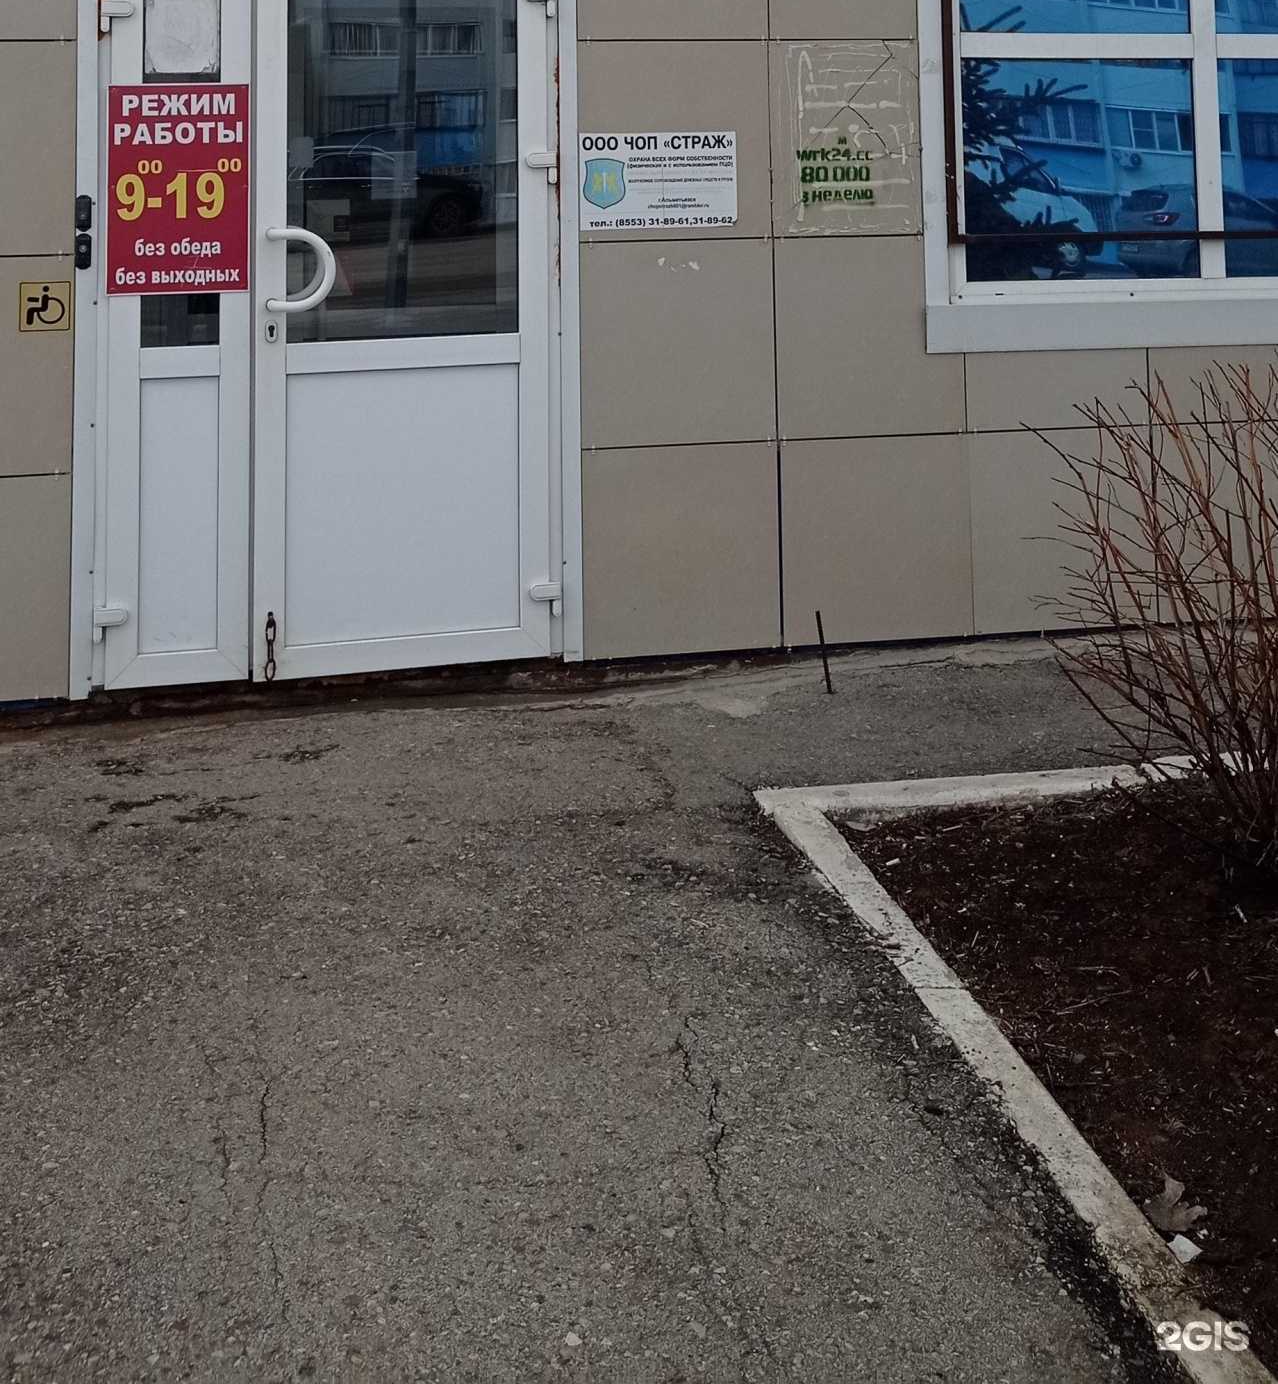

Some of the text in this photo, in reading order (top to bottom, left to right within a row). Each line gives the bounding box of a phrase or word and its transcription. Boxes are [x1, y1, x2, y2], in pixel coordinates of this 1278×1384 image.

[122, 93, 236, 117] РЕЖИМ
[113, 121, 244, 146] РАБОТЫ
[582, 134, 733, 151] ООО ЧОП «СТРАЖ»
[615, 218, 646, 227] (8553)
[134, 237, 222, 257] без обеда
[115, 267, 240, 287] без выходных
